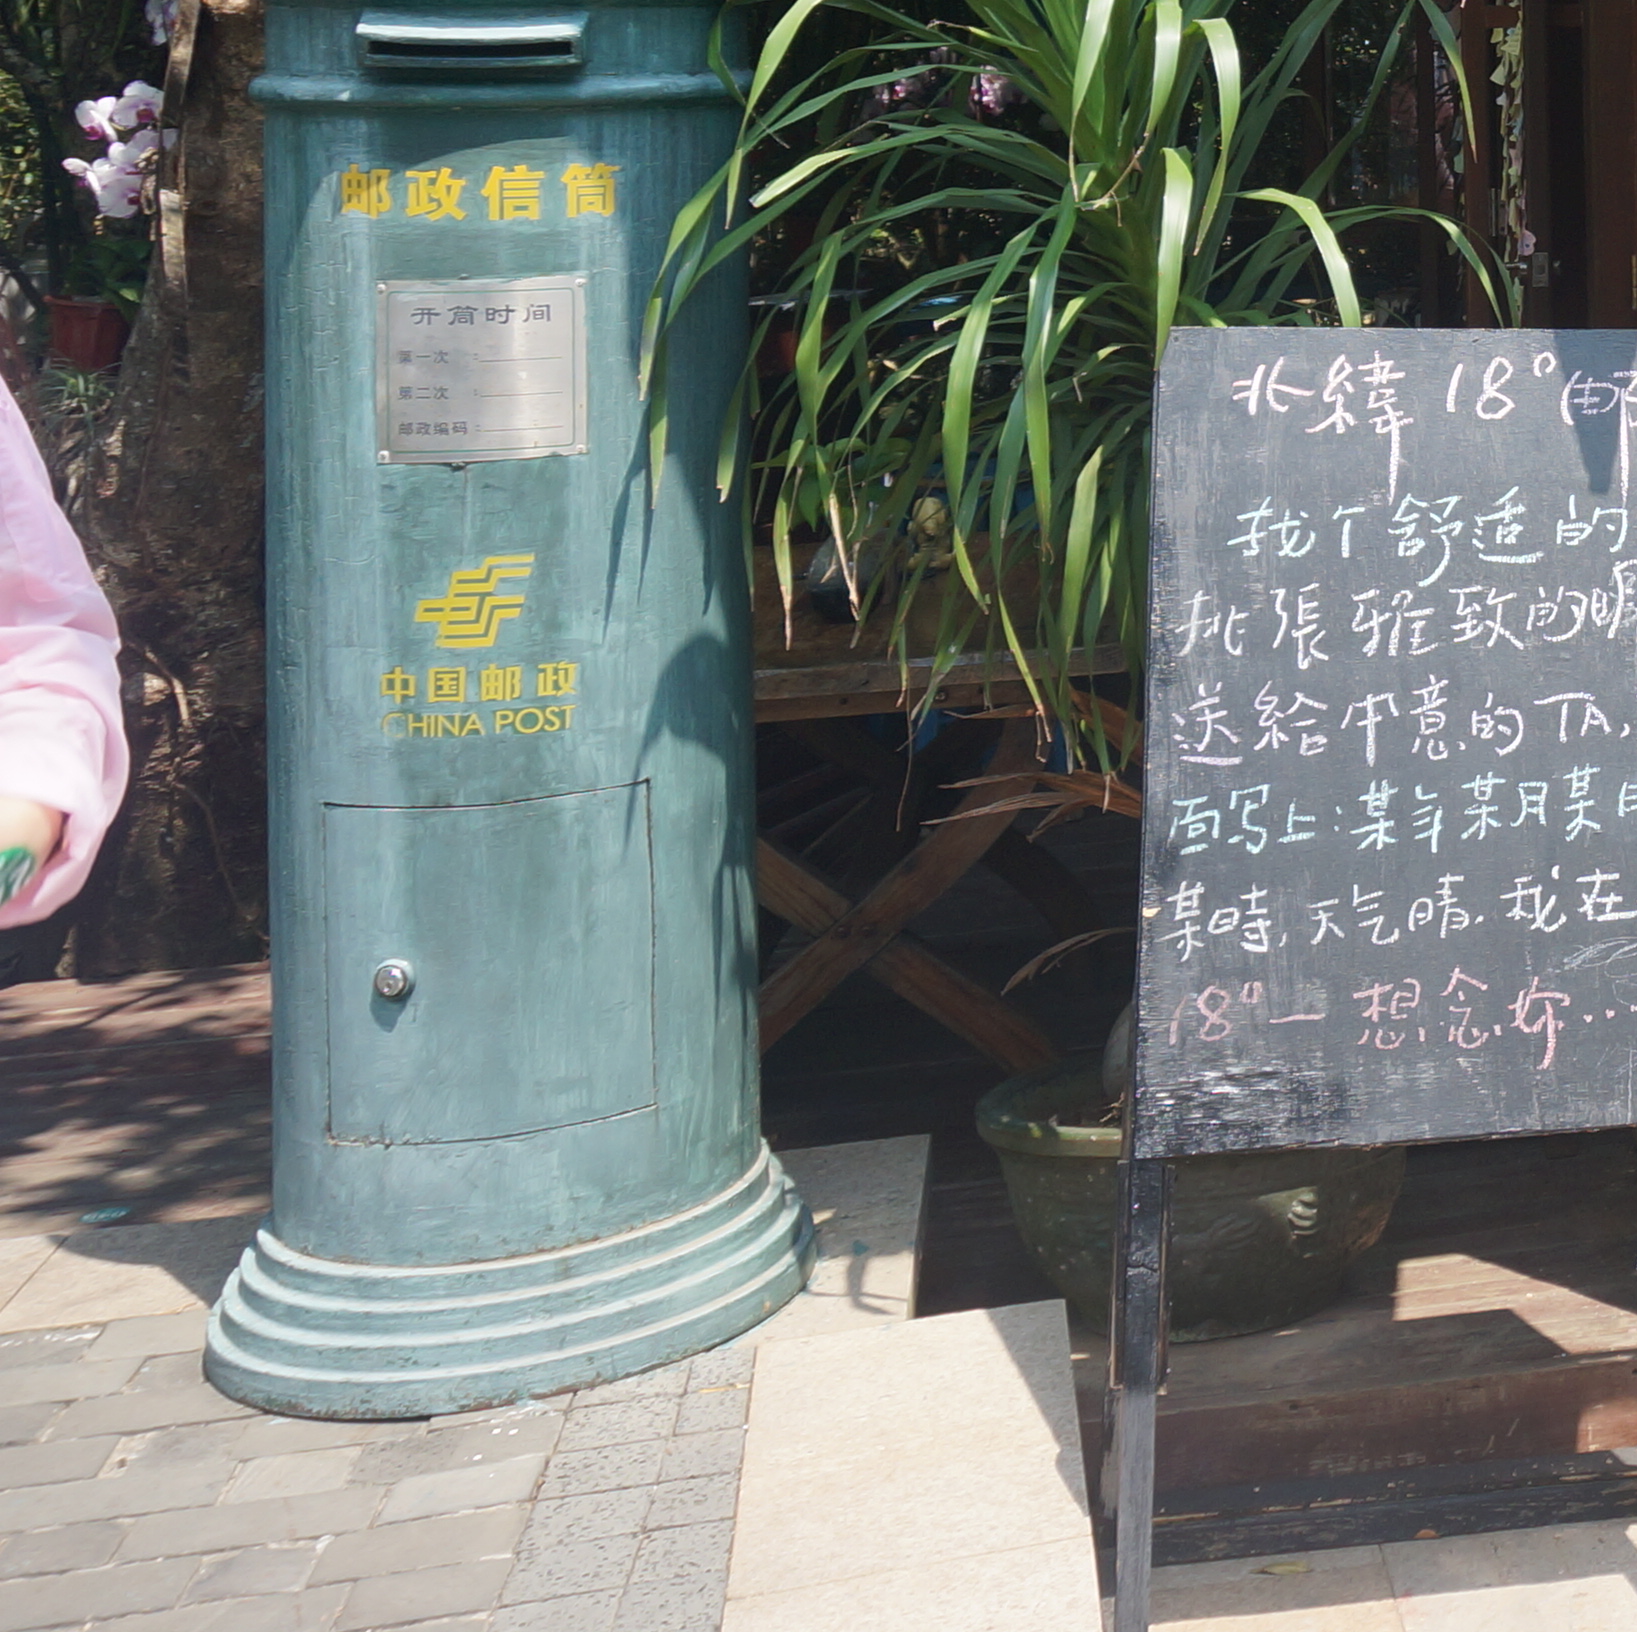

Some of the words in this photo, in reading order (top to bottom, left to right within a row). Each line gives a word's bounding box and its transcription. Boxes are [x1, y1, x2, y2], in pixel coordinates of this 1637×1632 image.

[340, 162, 620, 221] 邮政信筒
[410, 304, 552, 326] 开筒时间
[380, 661, 580, 704] 中国邮政
[382, 711, 486, 738] CHINA
[494, 704, 577, 735] POST
